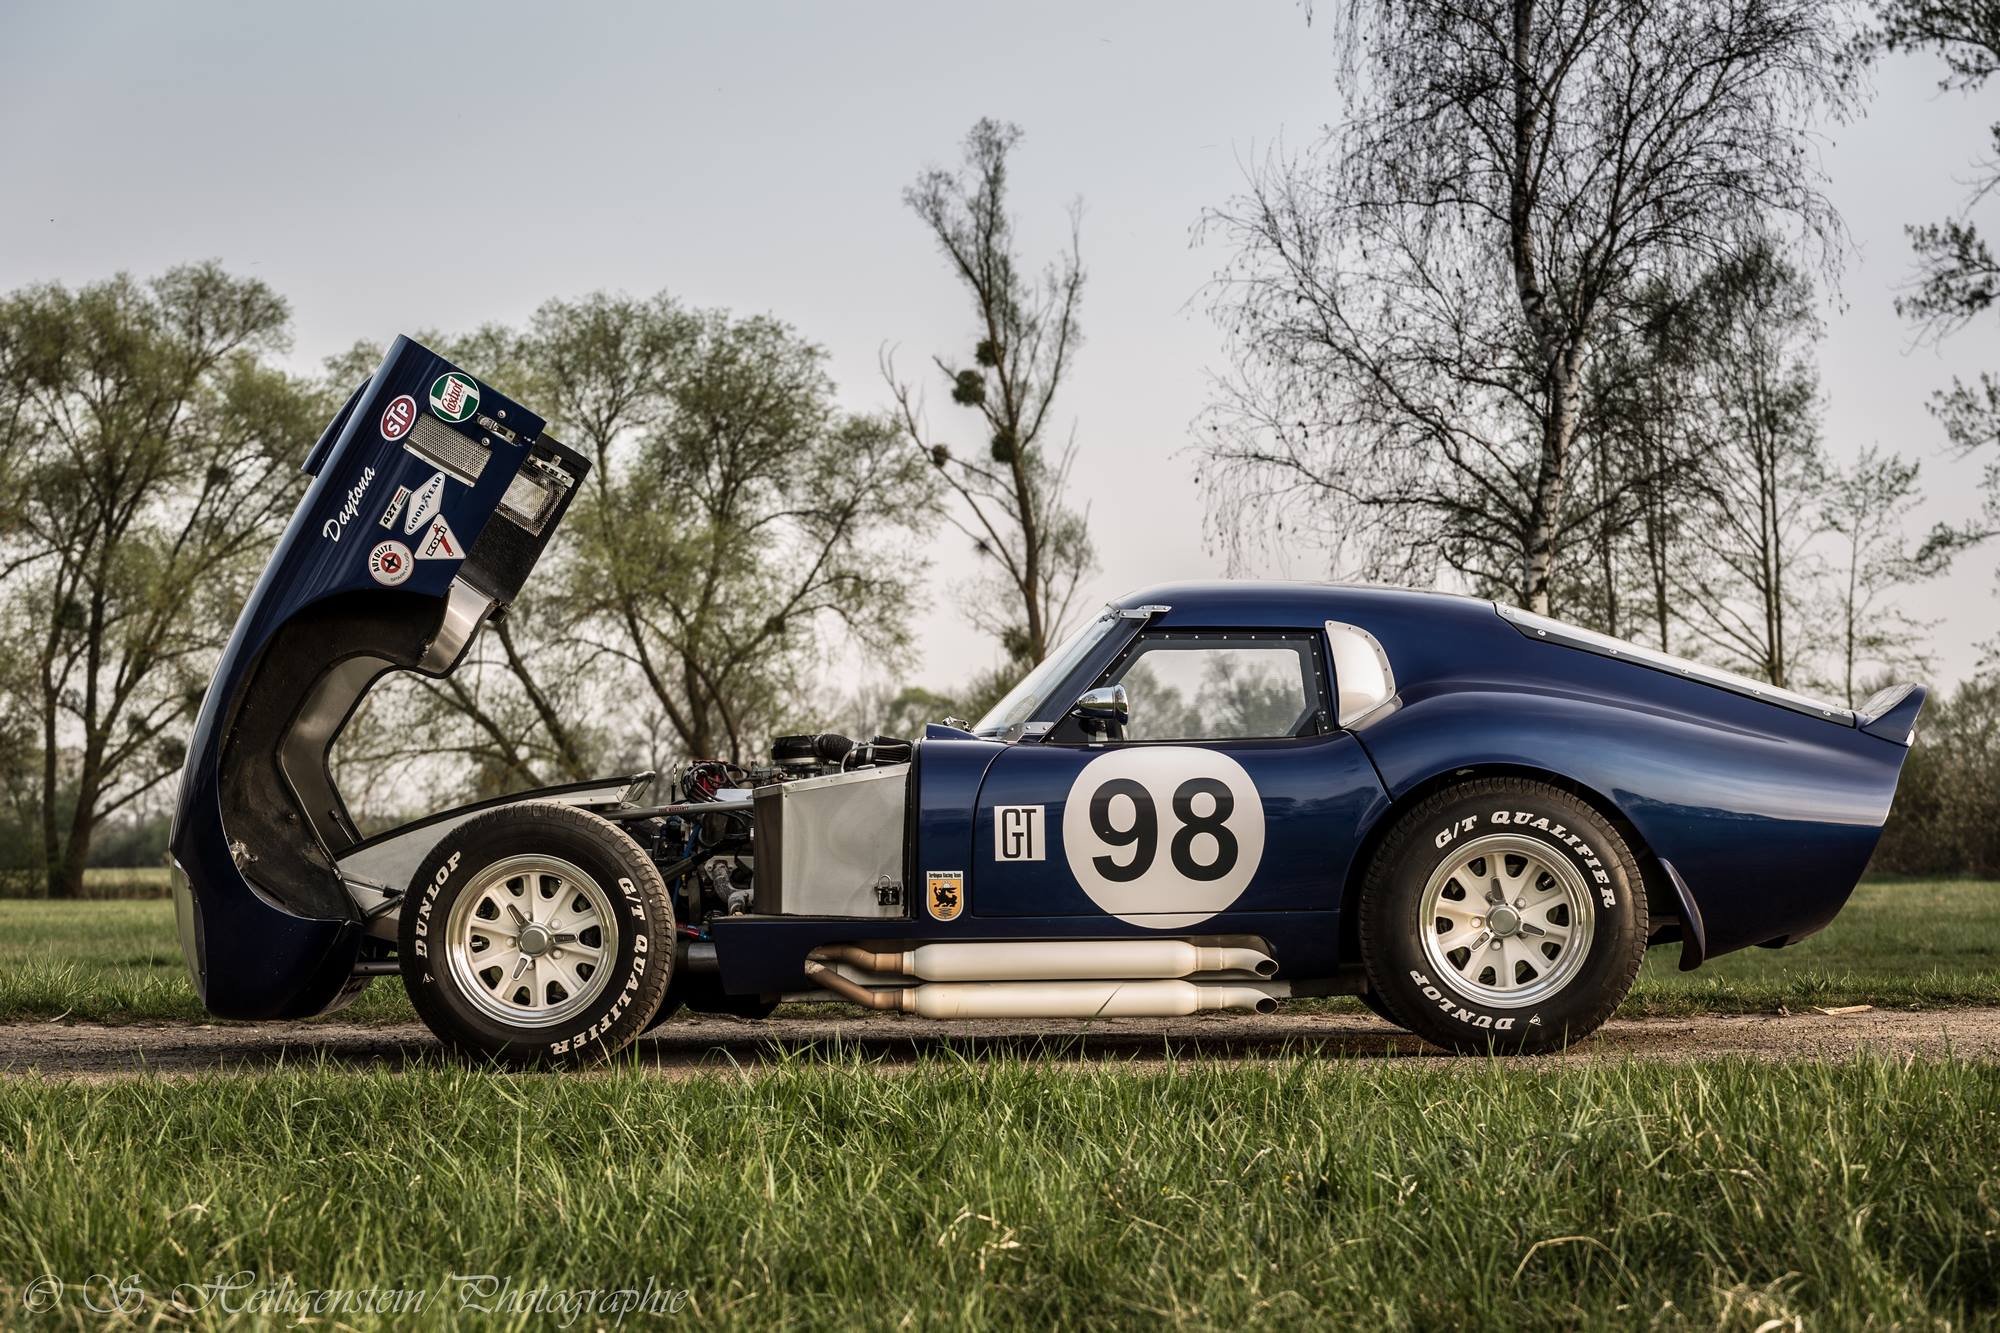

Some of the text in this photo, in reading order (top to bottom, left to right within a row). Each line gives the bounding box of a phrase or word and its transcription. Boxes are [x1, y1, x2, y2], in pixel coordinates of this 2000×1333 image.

[387, 402, 409, 436] STP
[441, 378, 464, 414] Castrol
[322, 466, 376, 543] Daytona
[382, 503, 398, 525] 427
[371, 544, 393, 573] AUTOLITE
[426, 525, 447, 557] KONI
[1001, 808, 1037, 859] GT
[1089, 777, 1239, 883] 98
[1434, 810, 1617, 909] G/T QUALIFIER
[415, 851, 462, 958] DUNLOP
[550, 877, 648, 1056] G/T QUALIFIER
[1409, 969, 1516, 1031] DUNLOP
